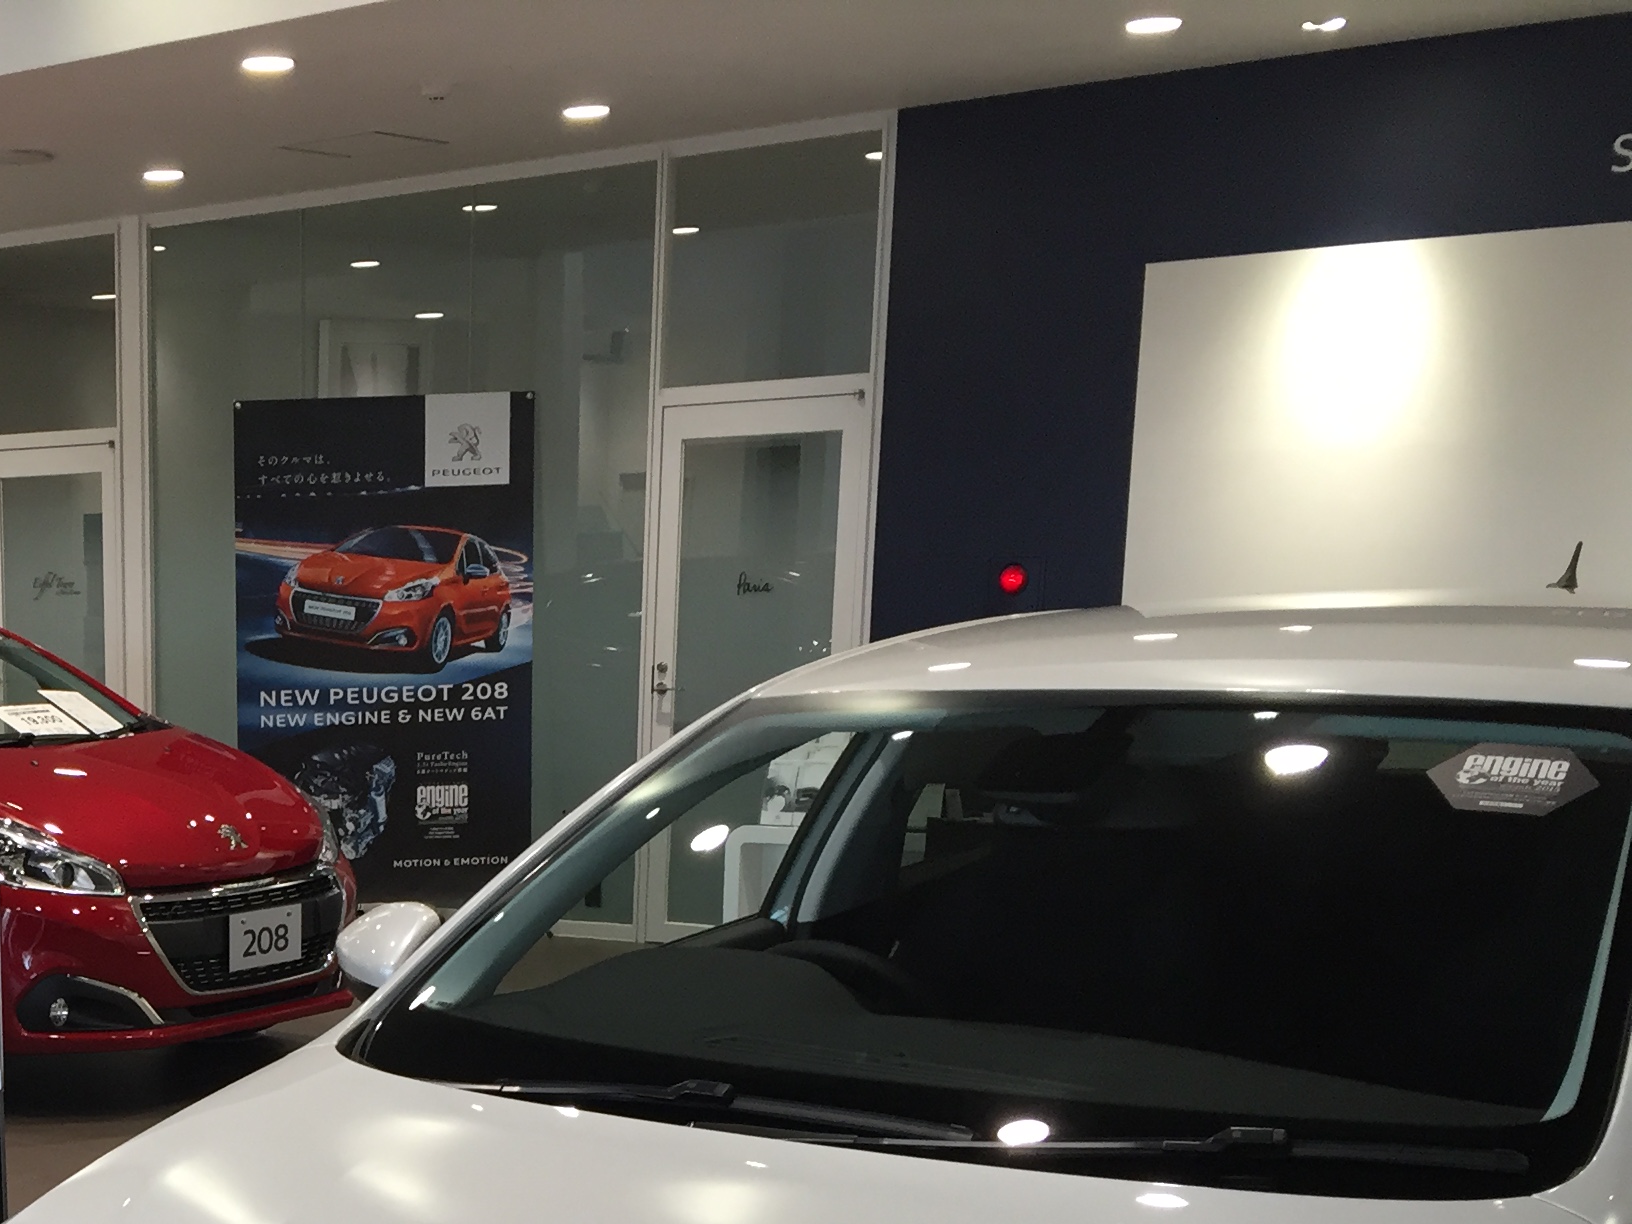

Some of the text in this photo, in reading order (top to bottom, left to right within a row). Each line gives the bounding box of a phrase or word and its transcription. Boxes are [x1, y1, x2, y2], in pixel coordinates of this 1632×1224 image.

[431, 466, 502, 477] PEUGEOT
[736, 571, 774, 596] Paris
[259, 682, 509, 707] NEW PEUGEOT 208
[260, 705, 508, 728] NEW ENGINE & NEW 6AT
[416, 750, 468, 761] PureTech
[1462, 754, 1570, 781] engine
[1490, 775, 1564, 787] of the year
[416, 784, 469, 808] engine
[393, 858, 440, 868] MOTION
[454, 855, 508, 866] EMOTION
[242, 923, 290, 958] 208
